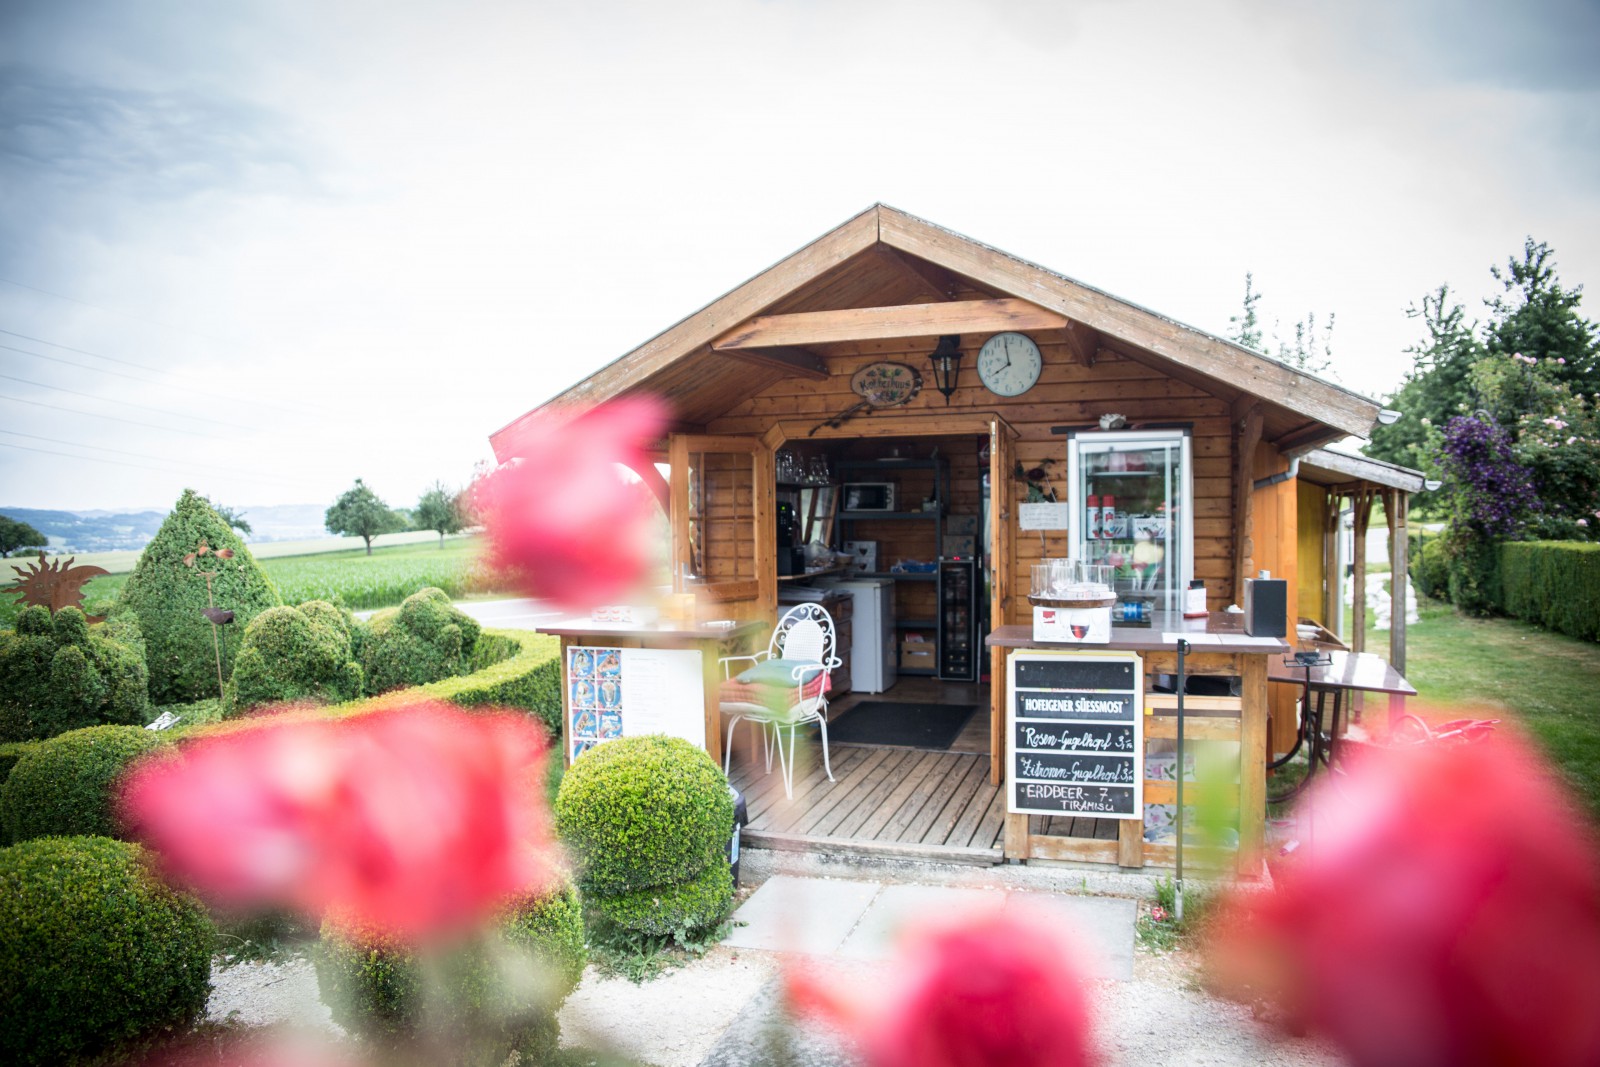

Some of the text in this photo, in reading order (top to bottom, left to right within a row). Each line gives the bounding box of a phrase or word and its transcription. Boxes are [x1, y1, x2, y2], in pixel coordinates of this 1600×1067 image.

[1025, 698, 1123, 714] HOFEIGENER SÜESSMOST
[1026, 784, 1089, 800] ERDBEER-
[1059, 800, 1114, 812] TIRAMISU
